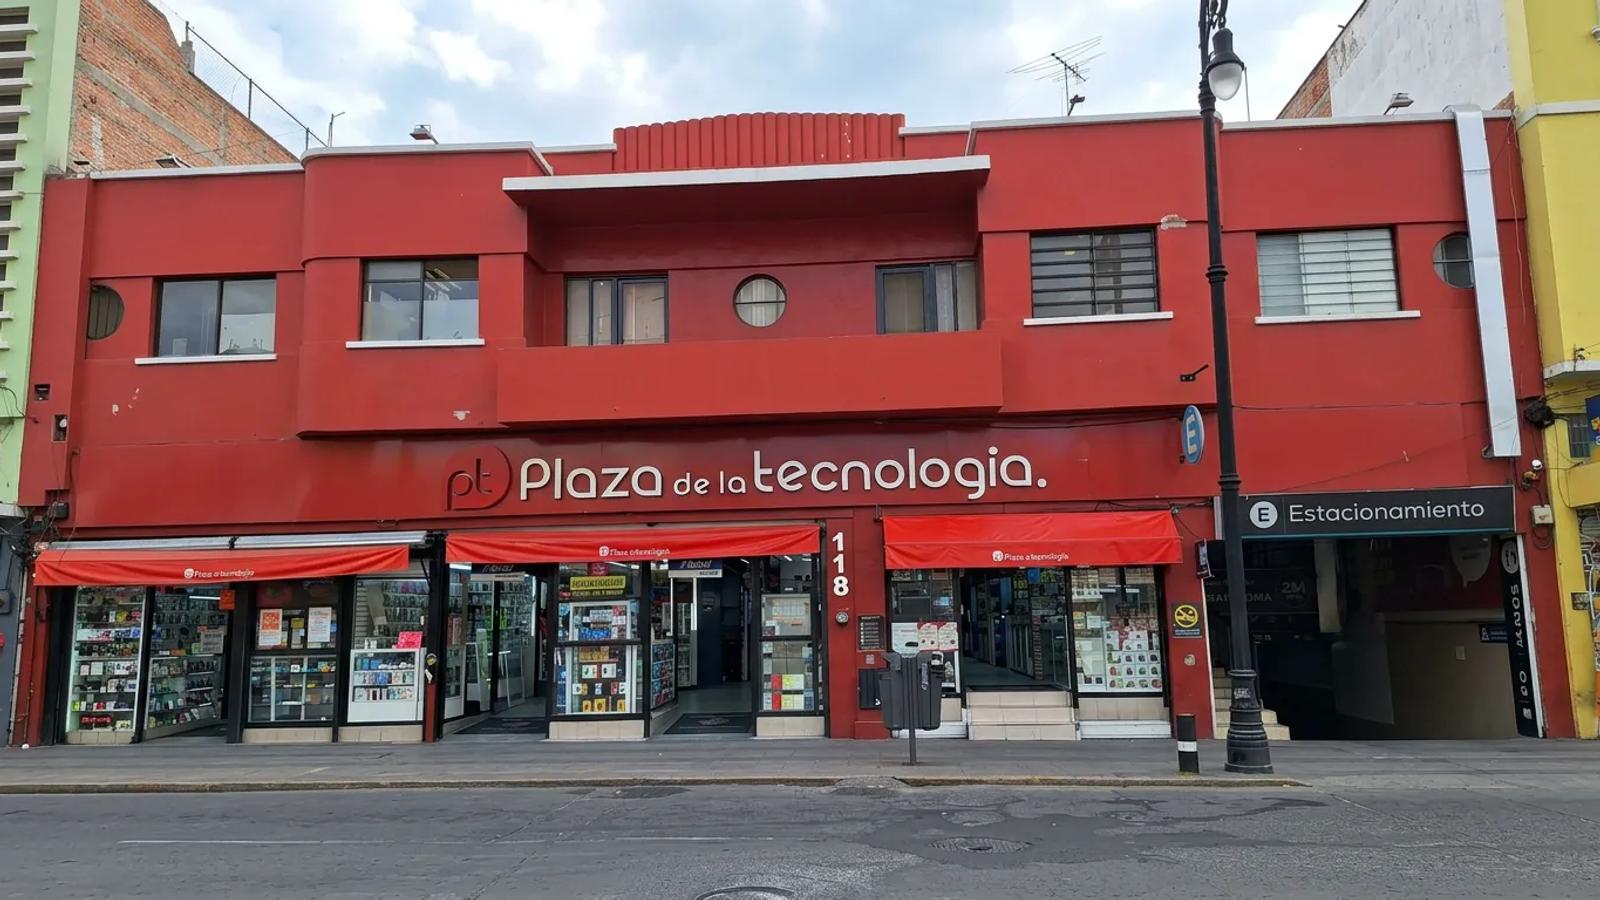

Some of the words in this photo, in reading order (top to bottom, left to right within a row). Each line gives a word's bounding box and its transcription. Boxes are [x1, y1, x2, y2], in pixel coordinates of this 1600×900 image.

[1186, 414, 1198, 455] E
[520, 458, 663, 500] Plaza
[673, 472, 711, 496] de
[719, 470, 747, 494] la
[753, 446, 1047, 500] tecnologia.
[1257, 507, 1270, 522] E
[1290, 501, 1485, 522] Estacionamiento
[832, 532, 849, 597] 118
